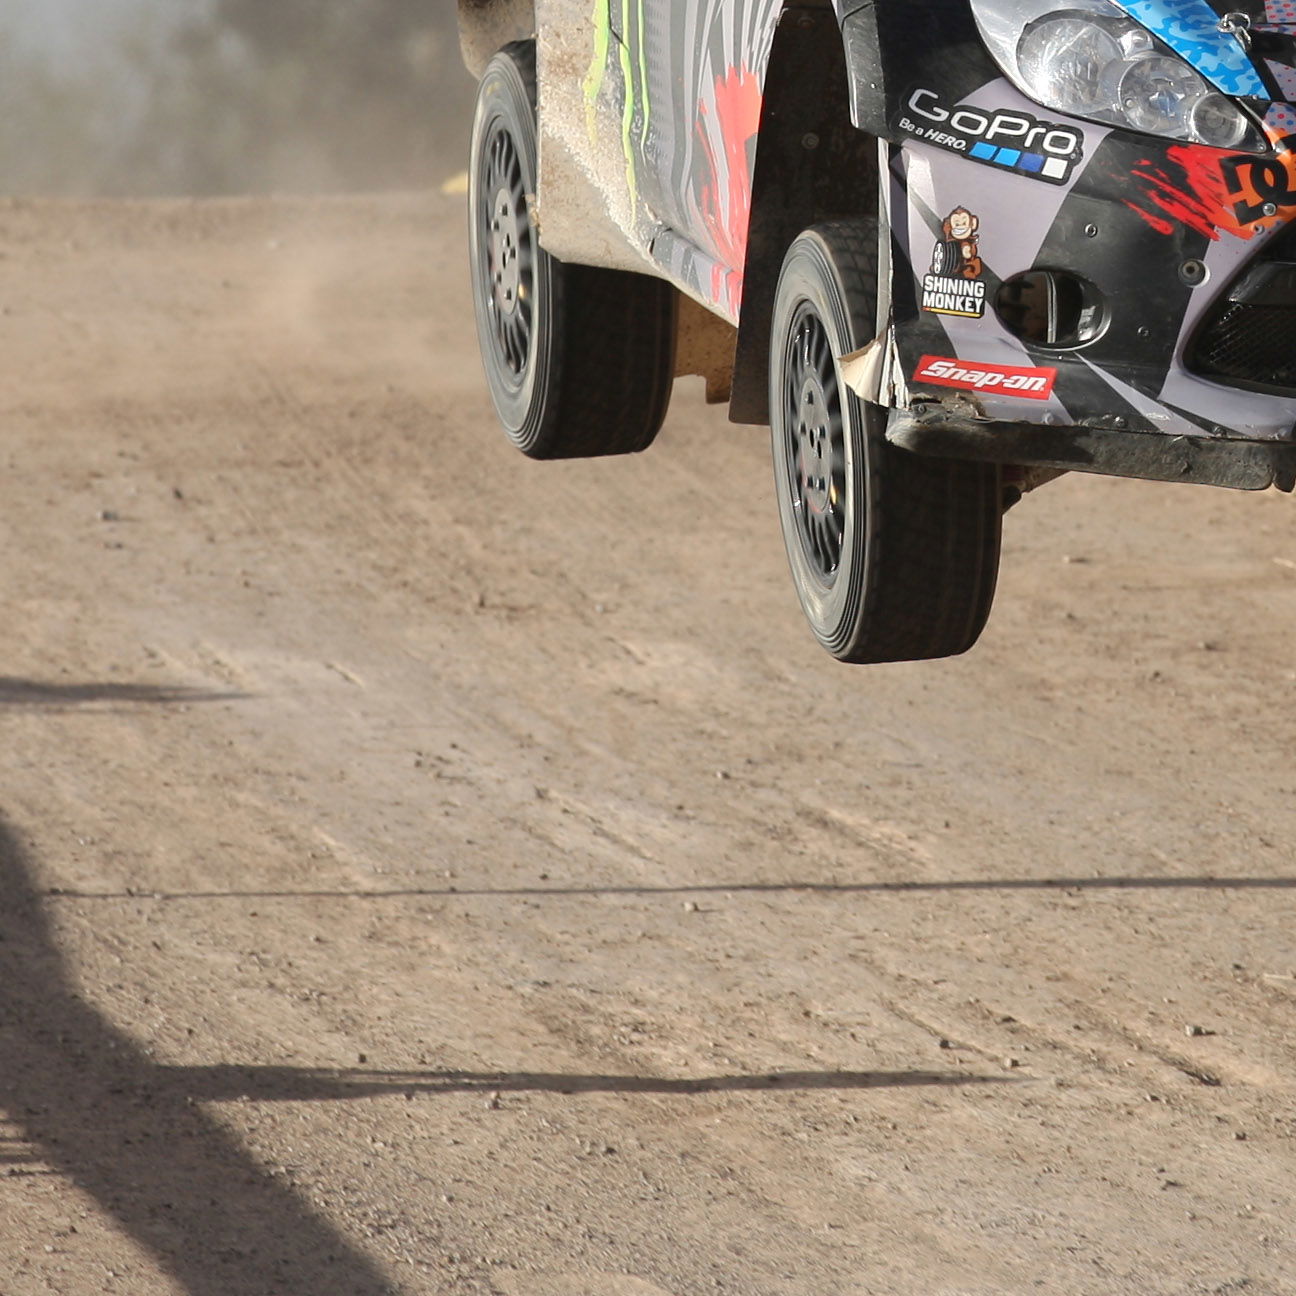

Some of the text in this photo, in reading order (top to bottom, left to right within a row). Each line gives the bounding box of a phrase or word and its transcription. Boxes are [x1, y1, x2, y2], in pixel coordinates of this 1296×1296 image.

[898, 117, 966, 151] Be a HERO.
[908, 88, 1077, 156] GoPro
[923, 291, 984, 313] MONKEY
[924, 275, 985, 298] SHINING
[920, 360, 1048, 391] Snap-on
